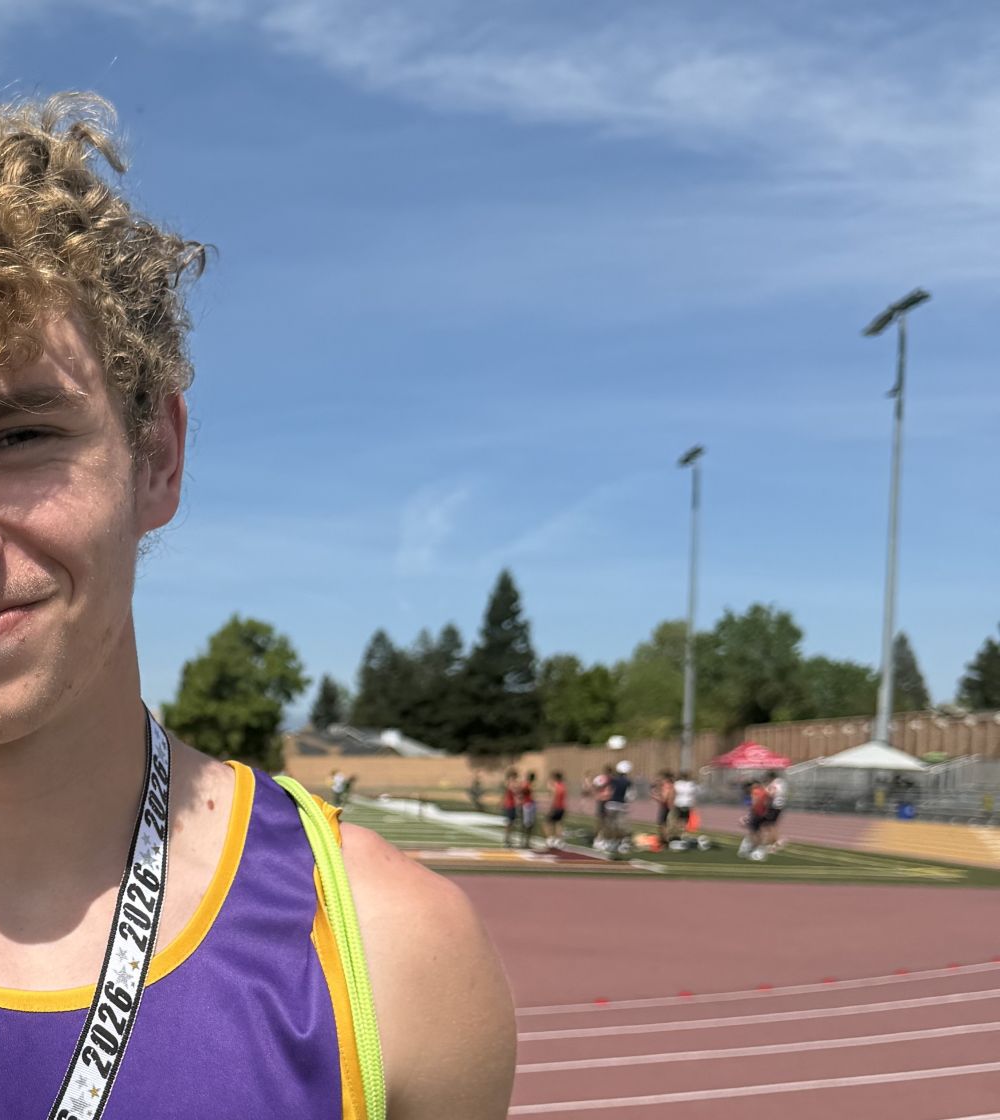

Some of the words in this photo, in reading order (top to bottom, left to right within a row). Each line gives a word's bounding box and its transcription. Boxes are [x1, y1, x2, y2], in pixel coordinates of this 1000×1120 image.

[82, 981, 132, 1080] 2026
[119, 863, 160, 953] 2026
[145, 754, 168, 841] 2026
